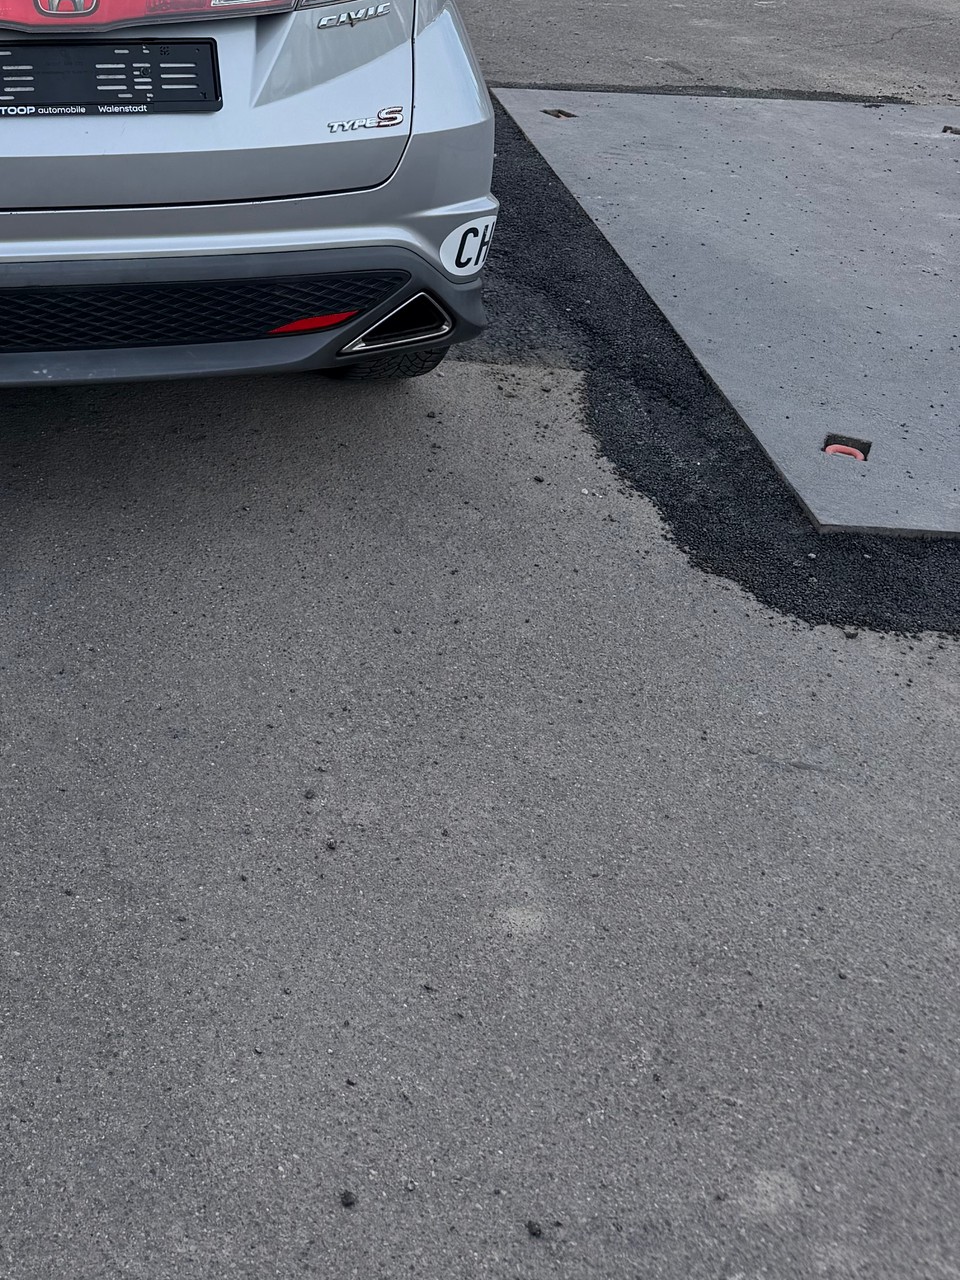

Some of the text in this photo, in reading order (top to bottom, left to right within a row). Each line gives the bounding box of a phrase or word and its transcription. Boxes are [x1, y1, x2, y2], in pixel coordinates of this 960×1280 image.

[317, 2, 391, 29] CIVIC
[37, 104, 86, 114] automobile
[97, 103, 148, 114] Walenstadt
[327, 105, 404, 134] TYPE S
[455, 222, 495, 268] CH
